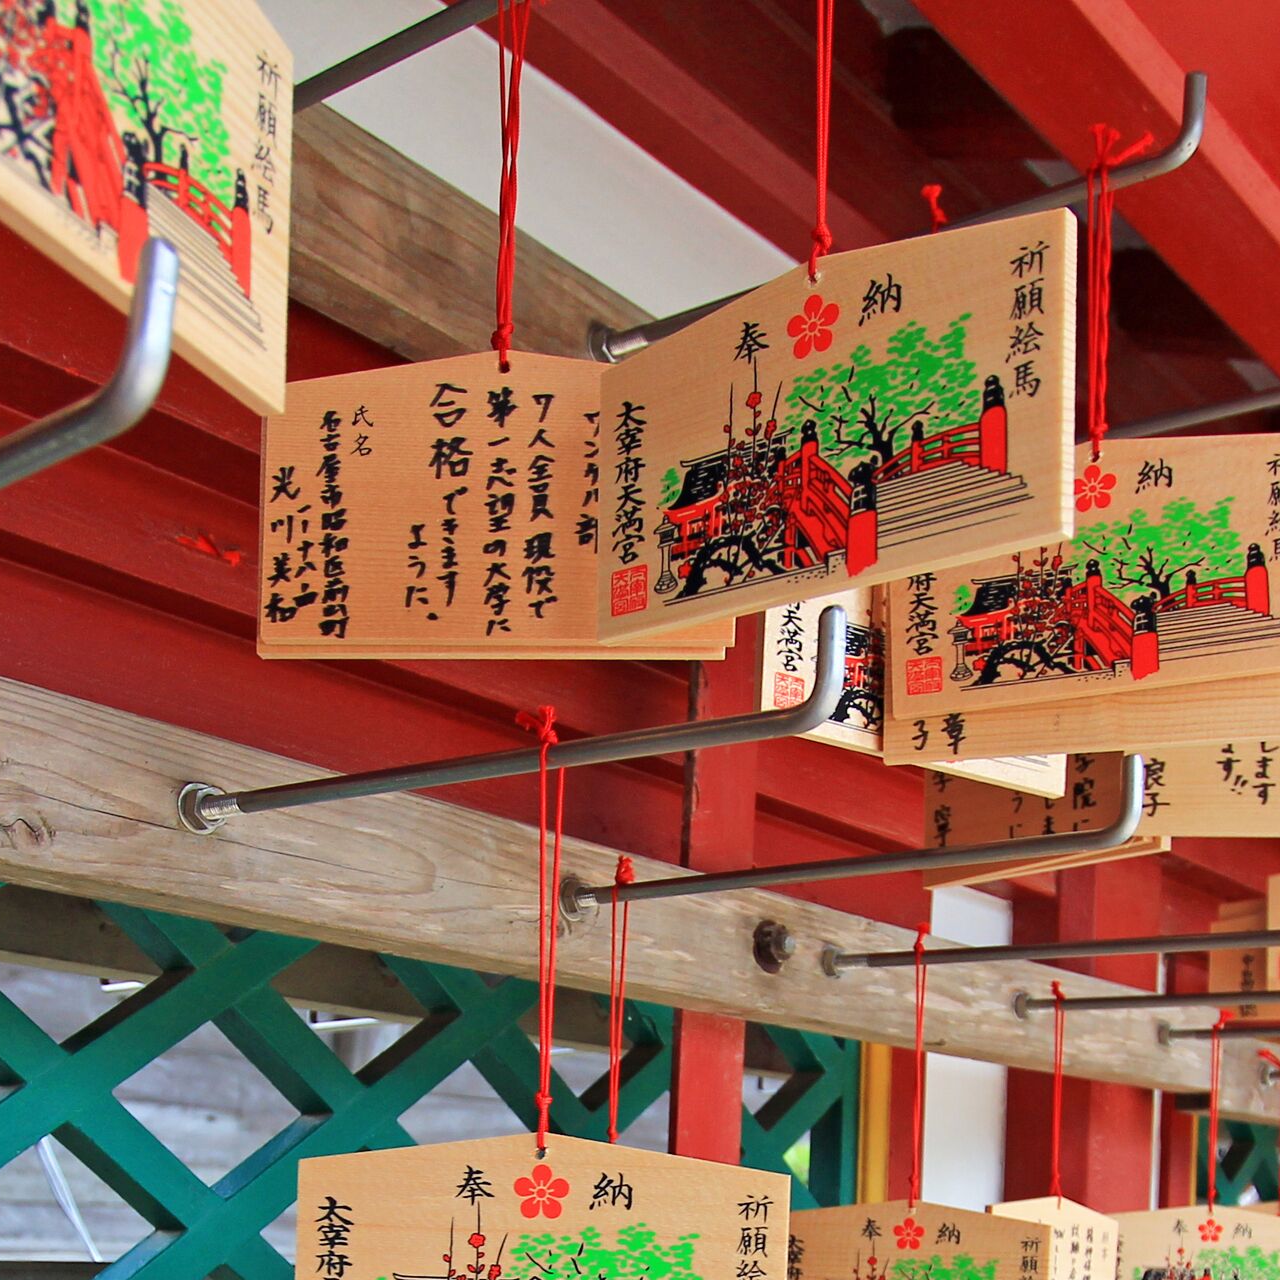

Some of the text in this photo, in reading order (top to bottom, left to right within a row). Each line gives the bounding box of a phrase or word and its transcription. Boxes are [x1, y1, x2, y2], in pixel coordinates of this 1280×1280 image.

[251, 48, 283, 235] 祈願絵馬
[733, 273, 902, 364] 奉 納
[1004, 241, 1050, 399] 祈願絵馬
[350, 404, 375, 458] 氏名
[1135, 458, 1172, 494] 納
[429, 382, 473, 607] 合格できます
[483, 386, 519, 636] 第一志望の大学に
[611, 401, 647, 565] 太宰府天満宮
[776, 600, 805, 672] 天満宮
[455, 1165, 633, 1211] 奉 納
[861, 1217, 961, 1245] 奉 納
